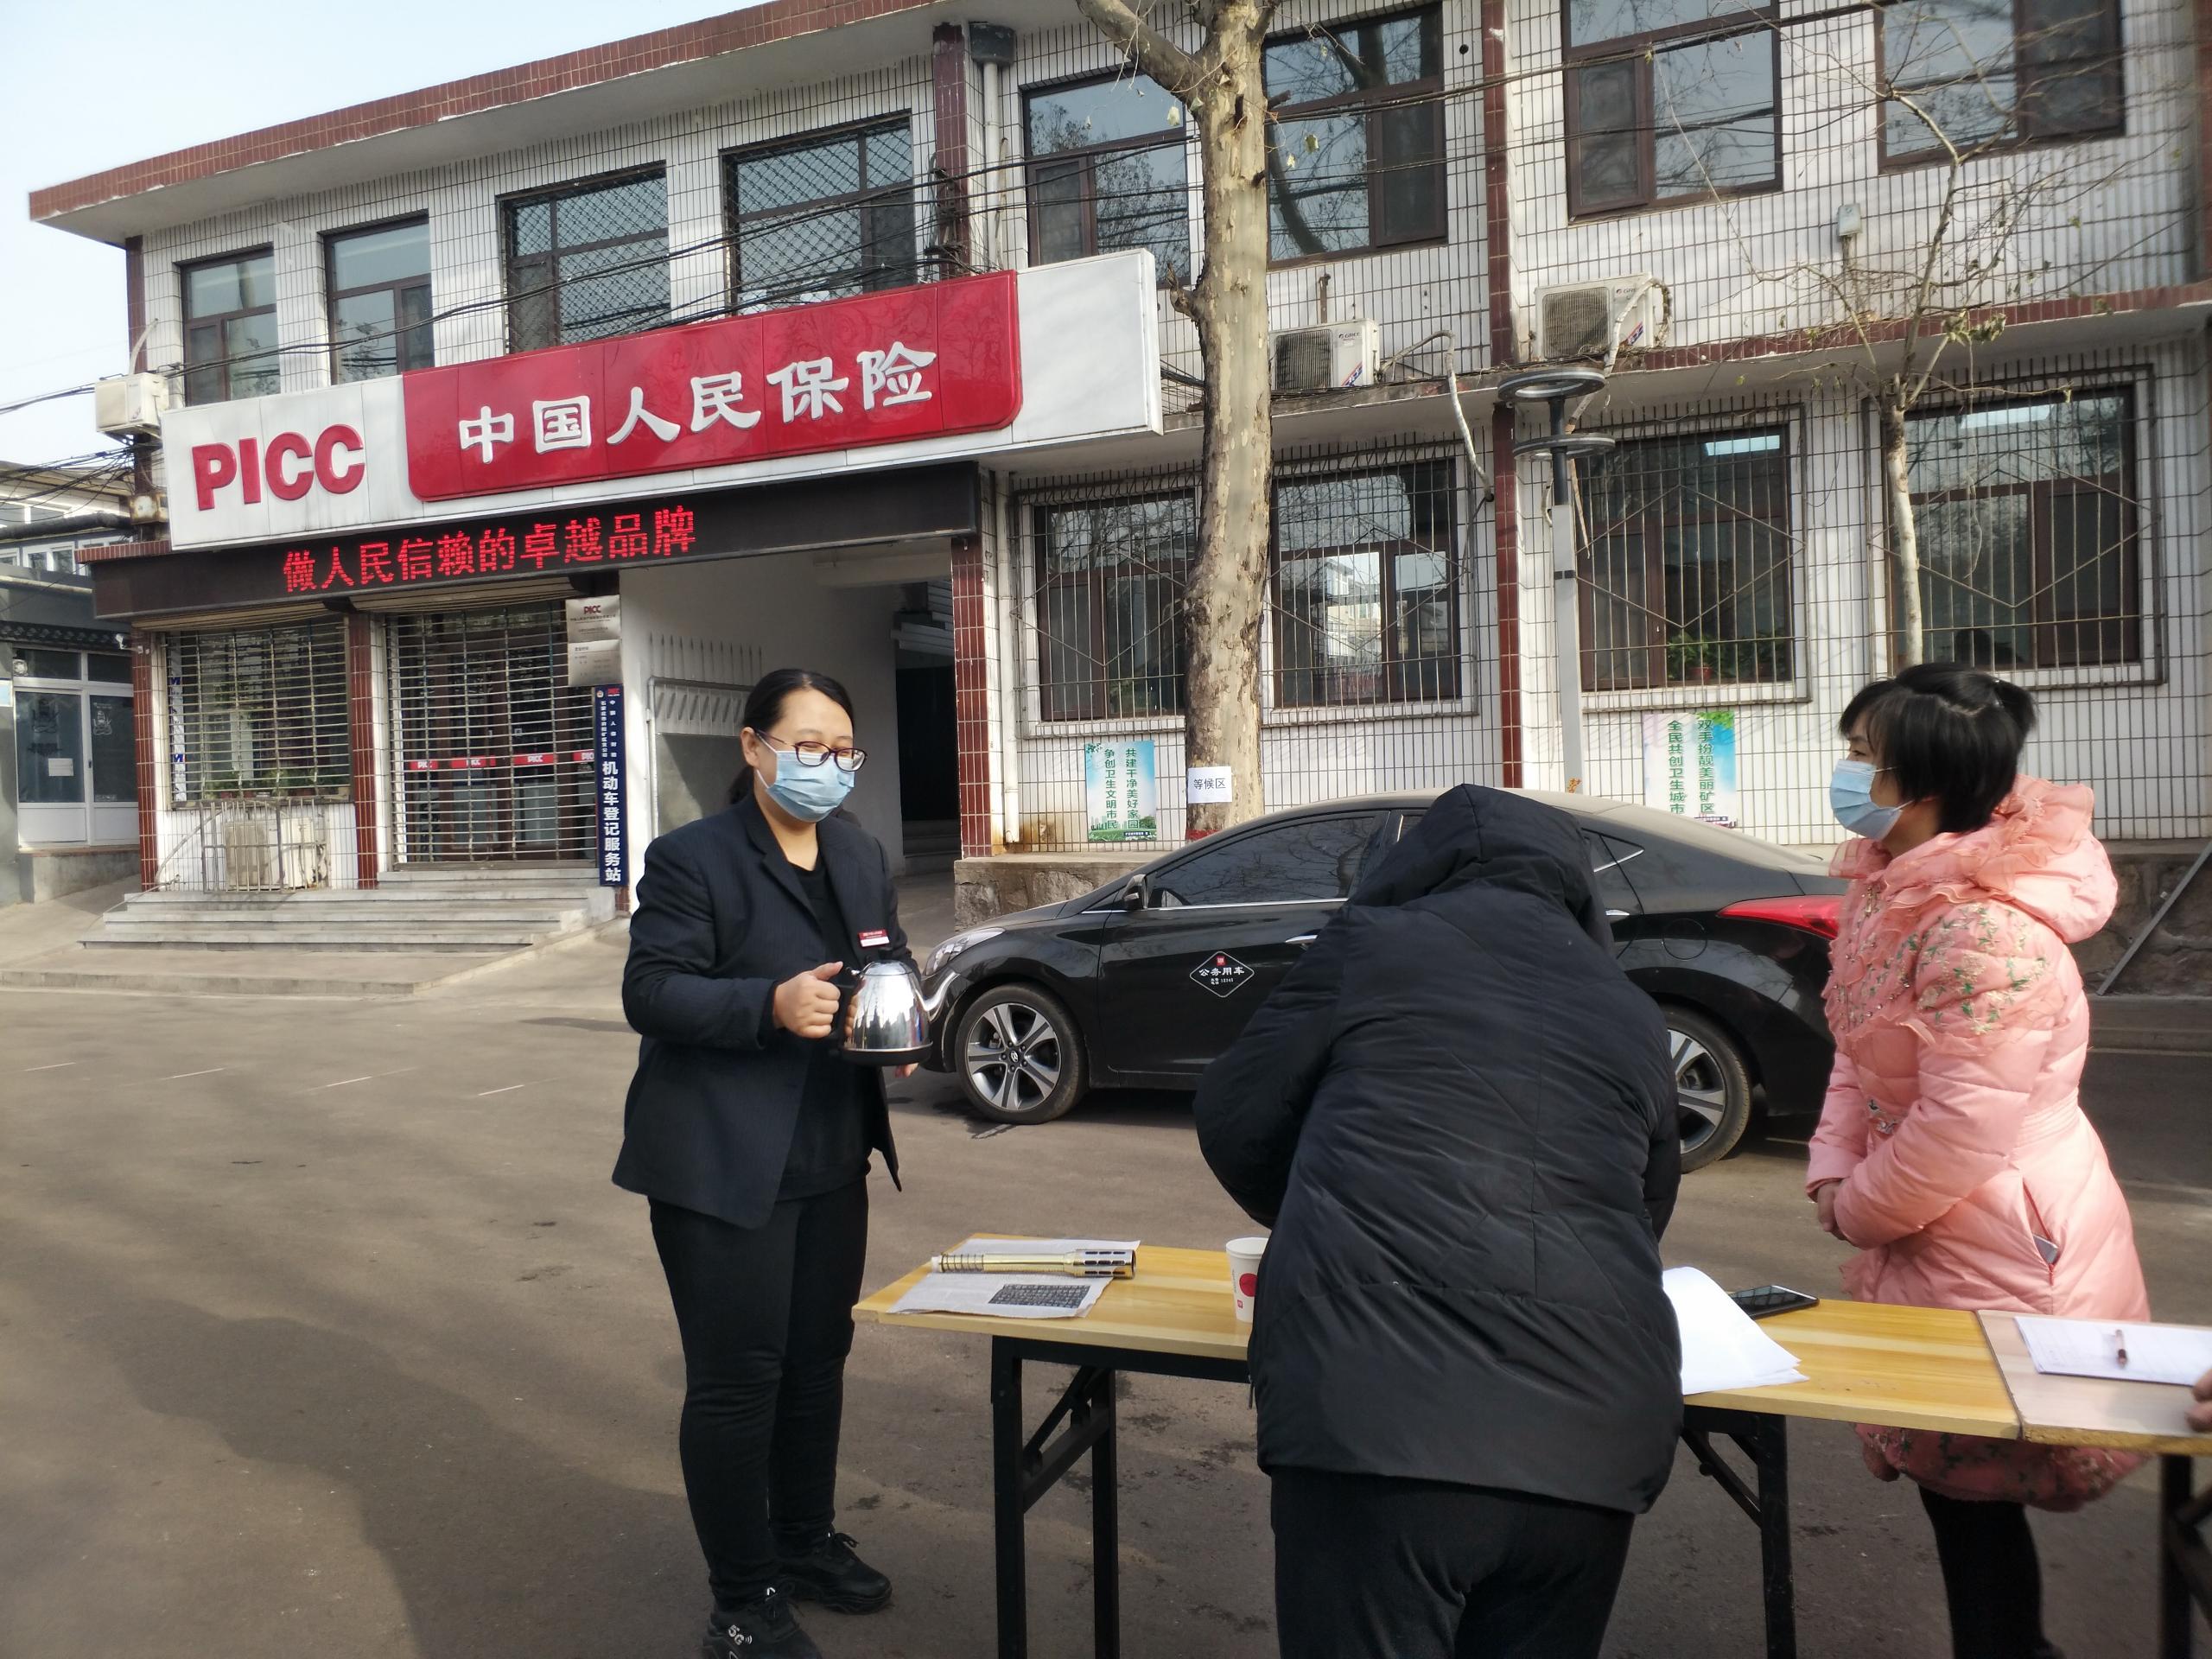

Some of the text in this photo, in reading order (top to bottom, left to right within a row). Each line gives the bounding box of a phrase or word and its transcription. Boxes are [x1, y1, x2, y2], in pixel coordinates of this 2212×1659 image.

[459, 340, 938, 464] 中国人民保险
[191, 423, 365, 511] PICC
[283, 505, 696, 593] 做人民信赖的卓越品牌
[583, 605, 601, 614] PICC
[1104, 748, 1117, 830] 争创卫生文明市民
[1125, 748, 1139, 829] 共建干净美好家园
[1193, 779, 1226, 790] 等候区
[1668, 720, 1686, 814] 全民共创卫生城市
[1697, 719, 1715, 814] 双手扮靓美丽矿区
[602, 761, 621, 883] 机动车登记服务站
[1199, 967, 1244, 976] 公务用车
